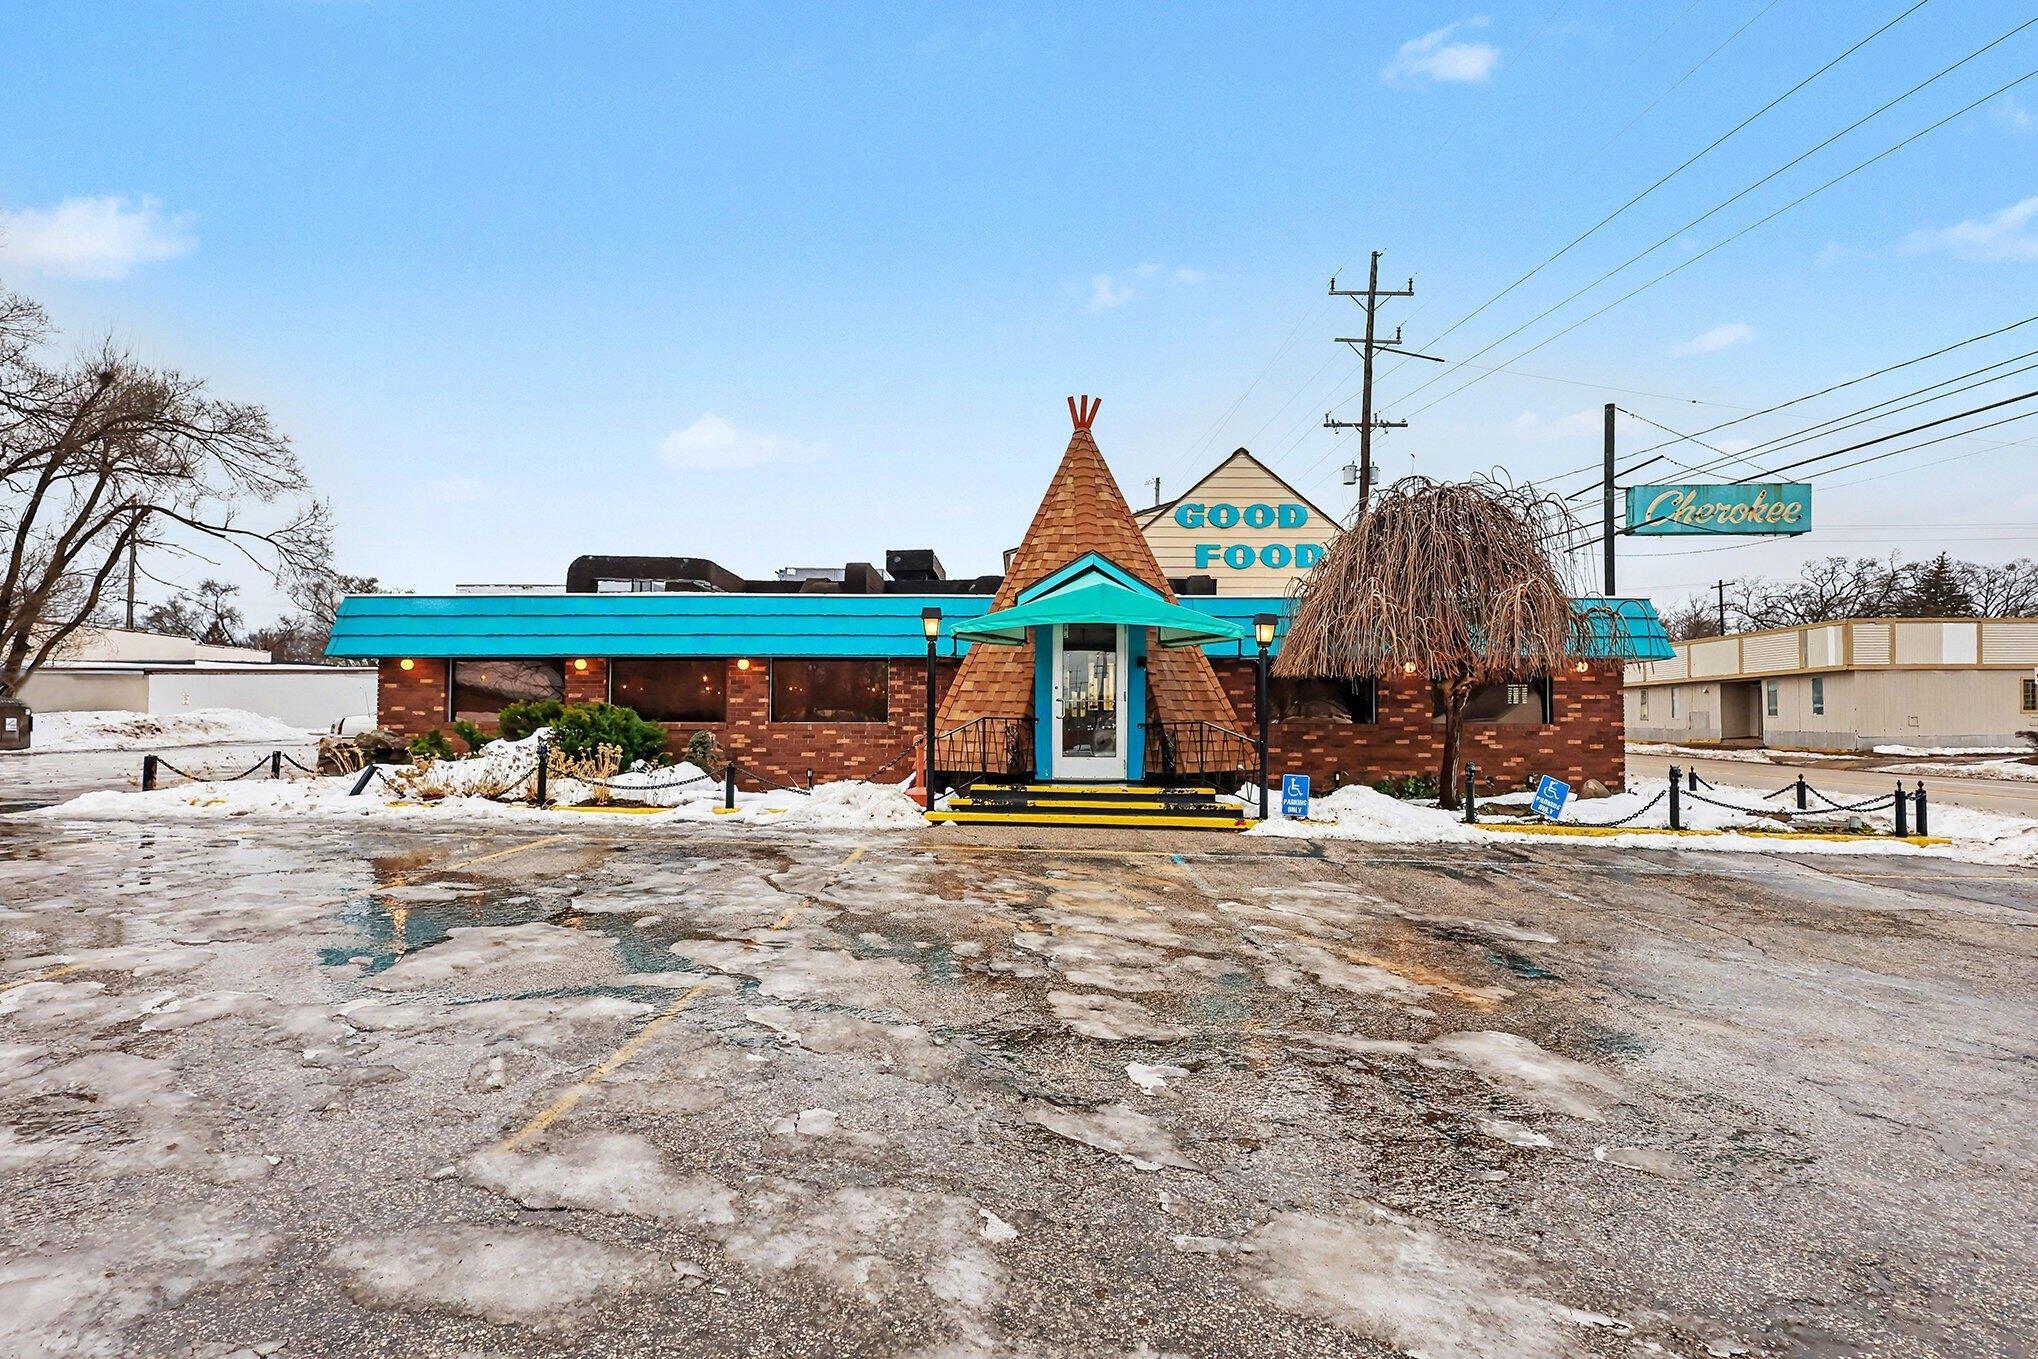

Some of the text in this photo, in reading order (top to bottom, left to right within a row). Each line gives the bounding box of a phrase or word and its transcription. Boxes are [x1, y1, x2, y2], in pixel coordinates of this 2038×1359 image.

[1174, 503, 1308, 529] GOOD
[1645, 489, 1802, 526] Cherokee
[1195, 543, 1325, 569] FOOD
[1283, 798, 1307, 806] PARKING
[1536, 796, 1562, 810] PARKING
[1538, 804, 1553, 815] ONLY
